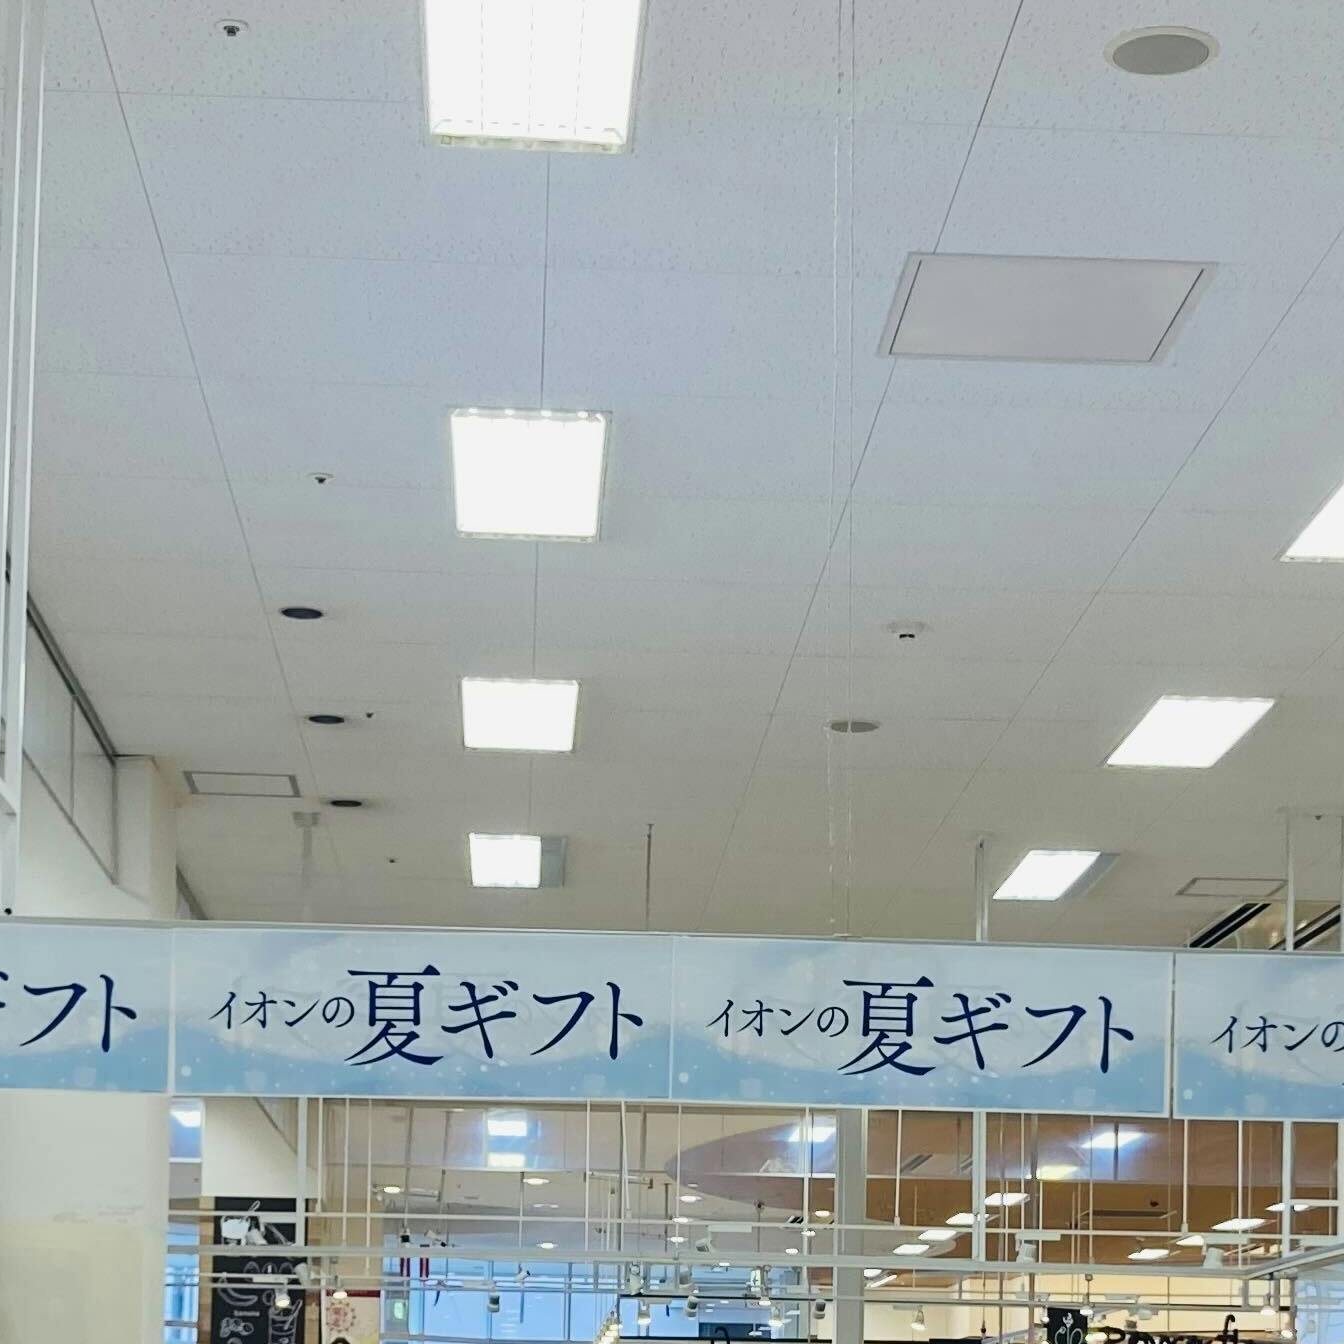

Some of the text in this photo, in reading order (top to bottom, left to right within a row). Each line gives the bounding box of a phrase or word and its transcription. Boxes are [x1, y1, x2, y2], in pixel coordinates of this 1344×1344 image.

[209, 965, 645, 1067] イオンの夏ギフト
[706, 976, 1135, 1077] イオンの夏ギフト
